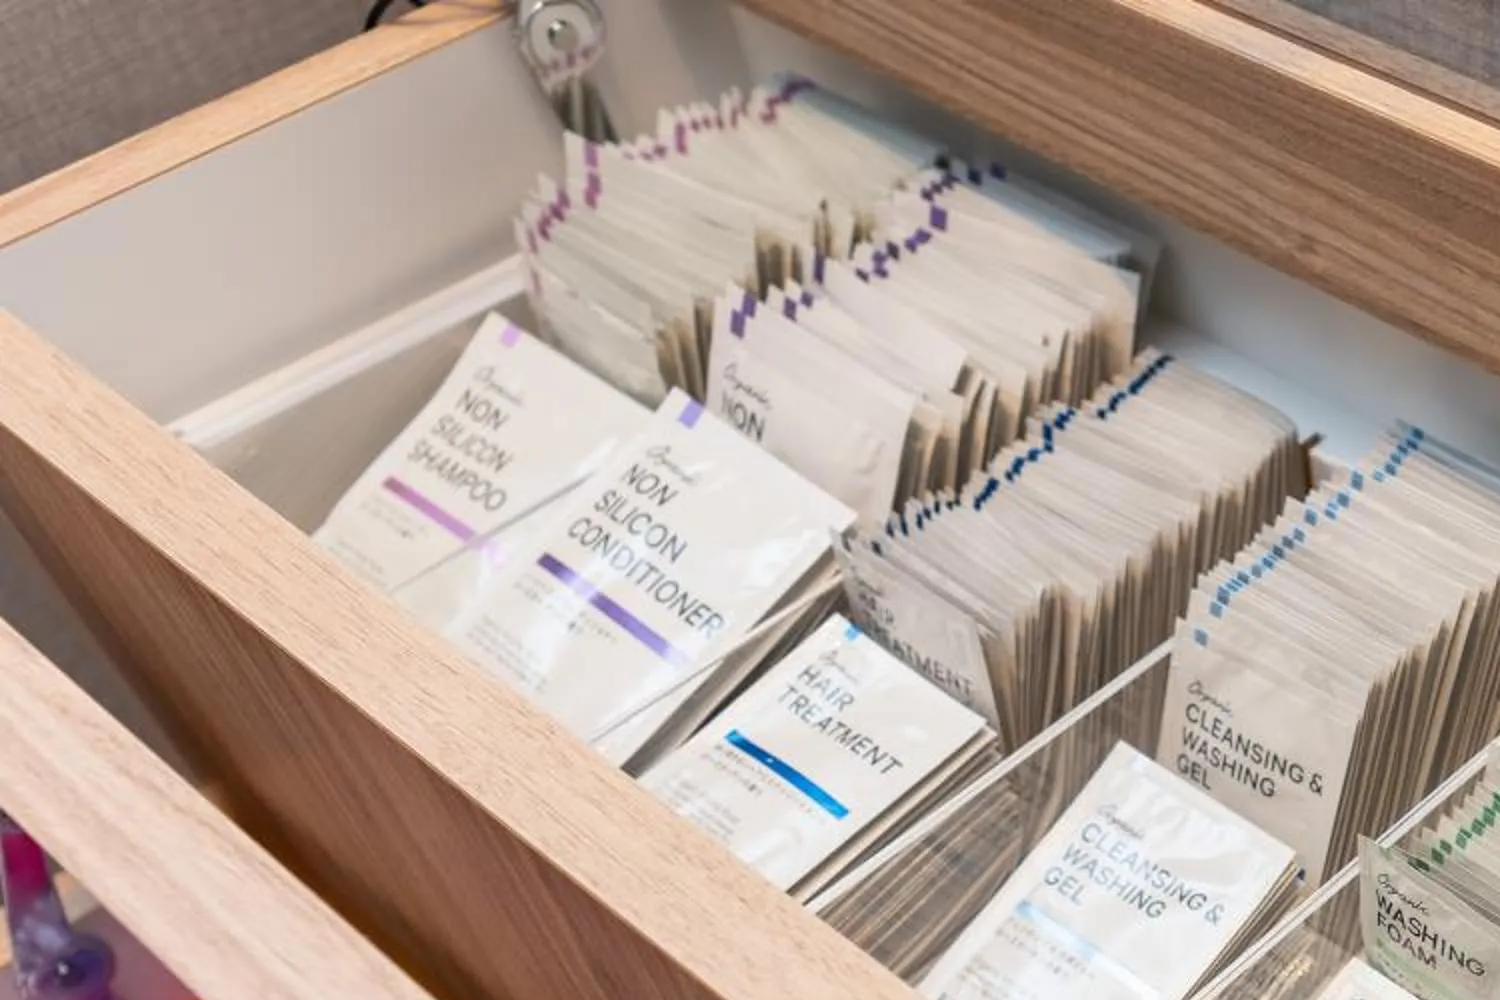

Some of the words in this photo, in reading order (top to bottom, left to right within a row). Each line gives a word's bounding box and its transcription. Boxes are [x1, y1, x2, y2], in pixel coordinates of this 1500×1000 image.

[455, 388, 506, 431] NON
[408, 439, 507, 512] SHAMPOO
[431, 416, 514, 473] SILICON
[622, 464, 678, 507] NON
[593, 491, 687, 566] SILICON
[568, 518, 726, 640] CONDITIONER
[797, 665, 855, 712] HAIR
[1188, 680, 1233, 718] Organic
[778, 684, 904, 776] TREATMENT
[1186, 703, 1304, 783] CLEANSING
[1308, 773, 1324, 796] &
[1176, 755, 1212, 790] GEL
[1181, 727, 1276, 798] WASHING
[1043, 866, 1084, 906] GEL
[1061, 843, 1168, 920] WASHING
[1081, 822, 1207, 911] CLEANSING
[1205, 903, 1225, 925] &
[1377, 874, 1430, 916] Organic
[1376, 888, 1485, 977] WASHING
[1377, 911, 1437, 969] FOAM
